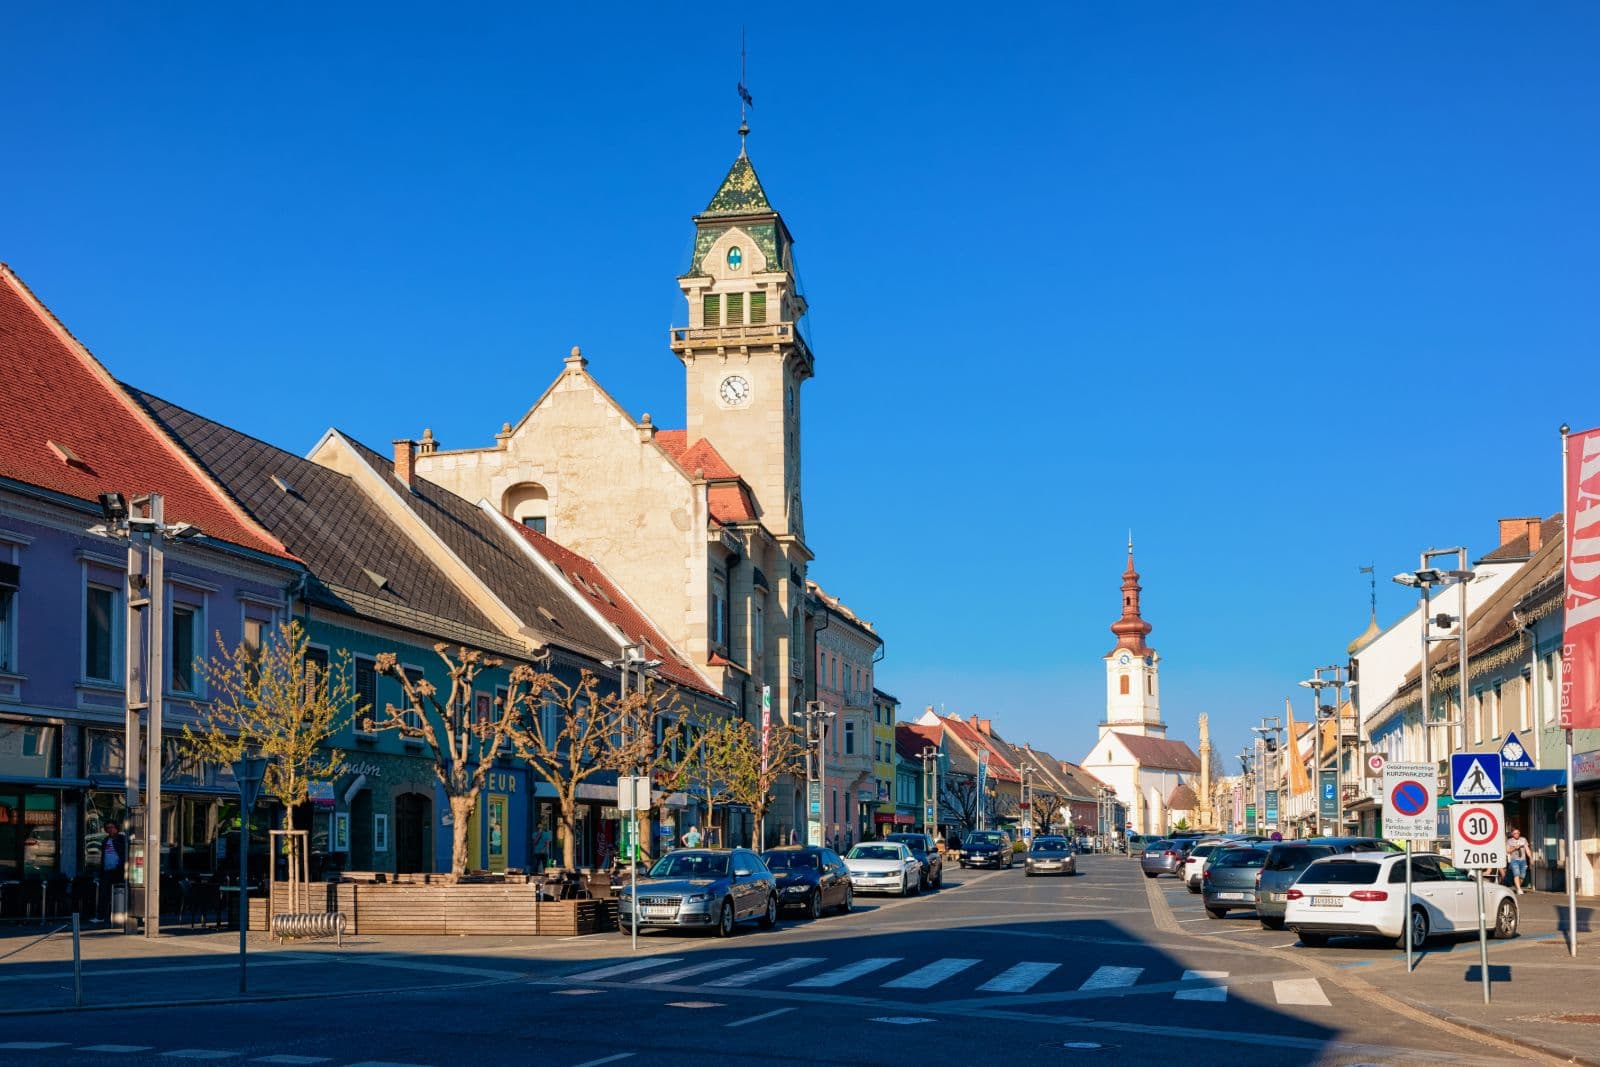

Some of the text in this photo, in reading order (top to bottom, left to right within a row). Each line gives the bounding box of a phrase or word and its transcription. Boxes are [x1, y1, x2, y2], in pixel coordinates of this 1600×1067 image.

[1561, 643, 1576, 727] bis bald
[1469, 817, 1488, 836] 30
[1464, 849, 1498, 865] Zone
